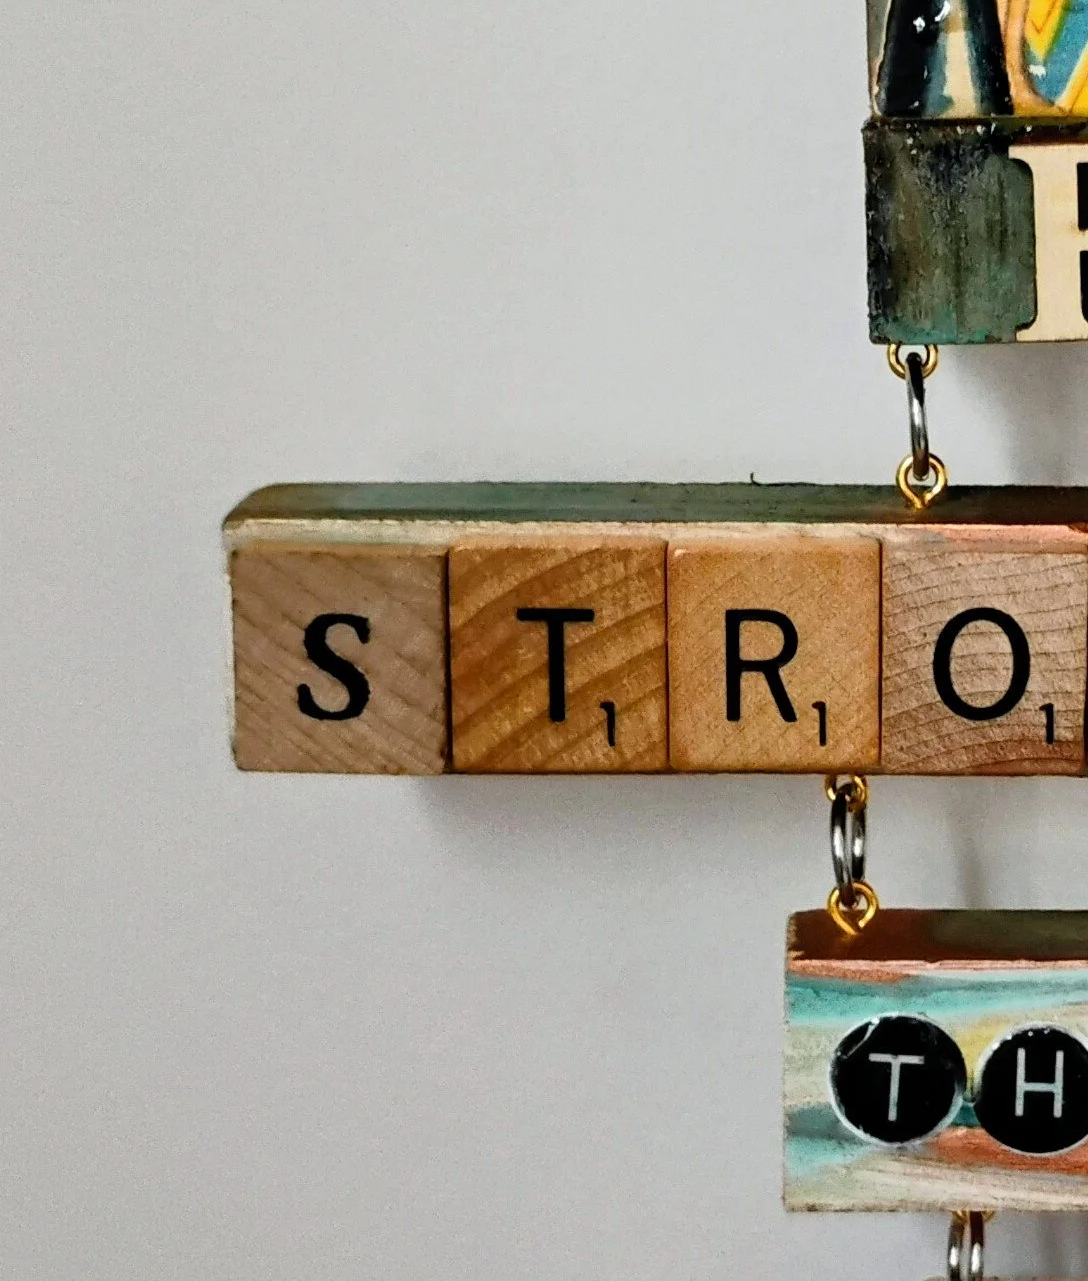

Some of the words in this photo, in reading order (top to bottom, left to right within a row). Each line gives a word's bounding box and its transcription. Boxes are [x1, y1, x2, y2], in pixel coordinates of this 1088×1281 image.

[599, 700, 617, 747] 1
[810, 700, 828, 747] 1
[1038, 702, 1055, 746] 1
